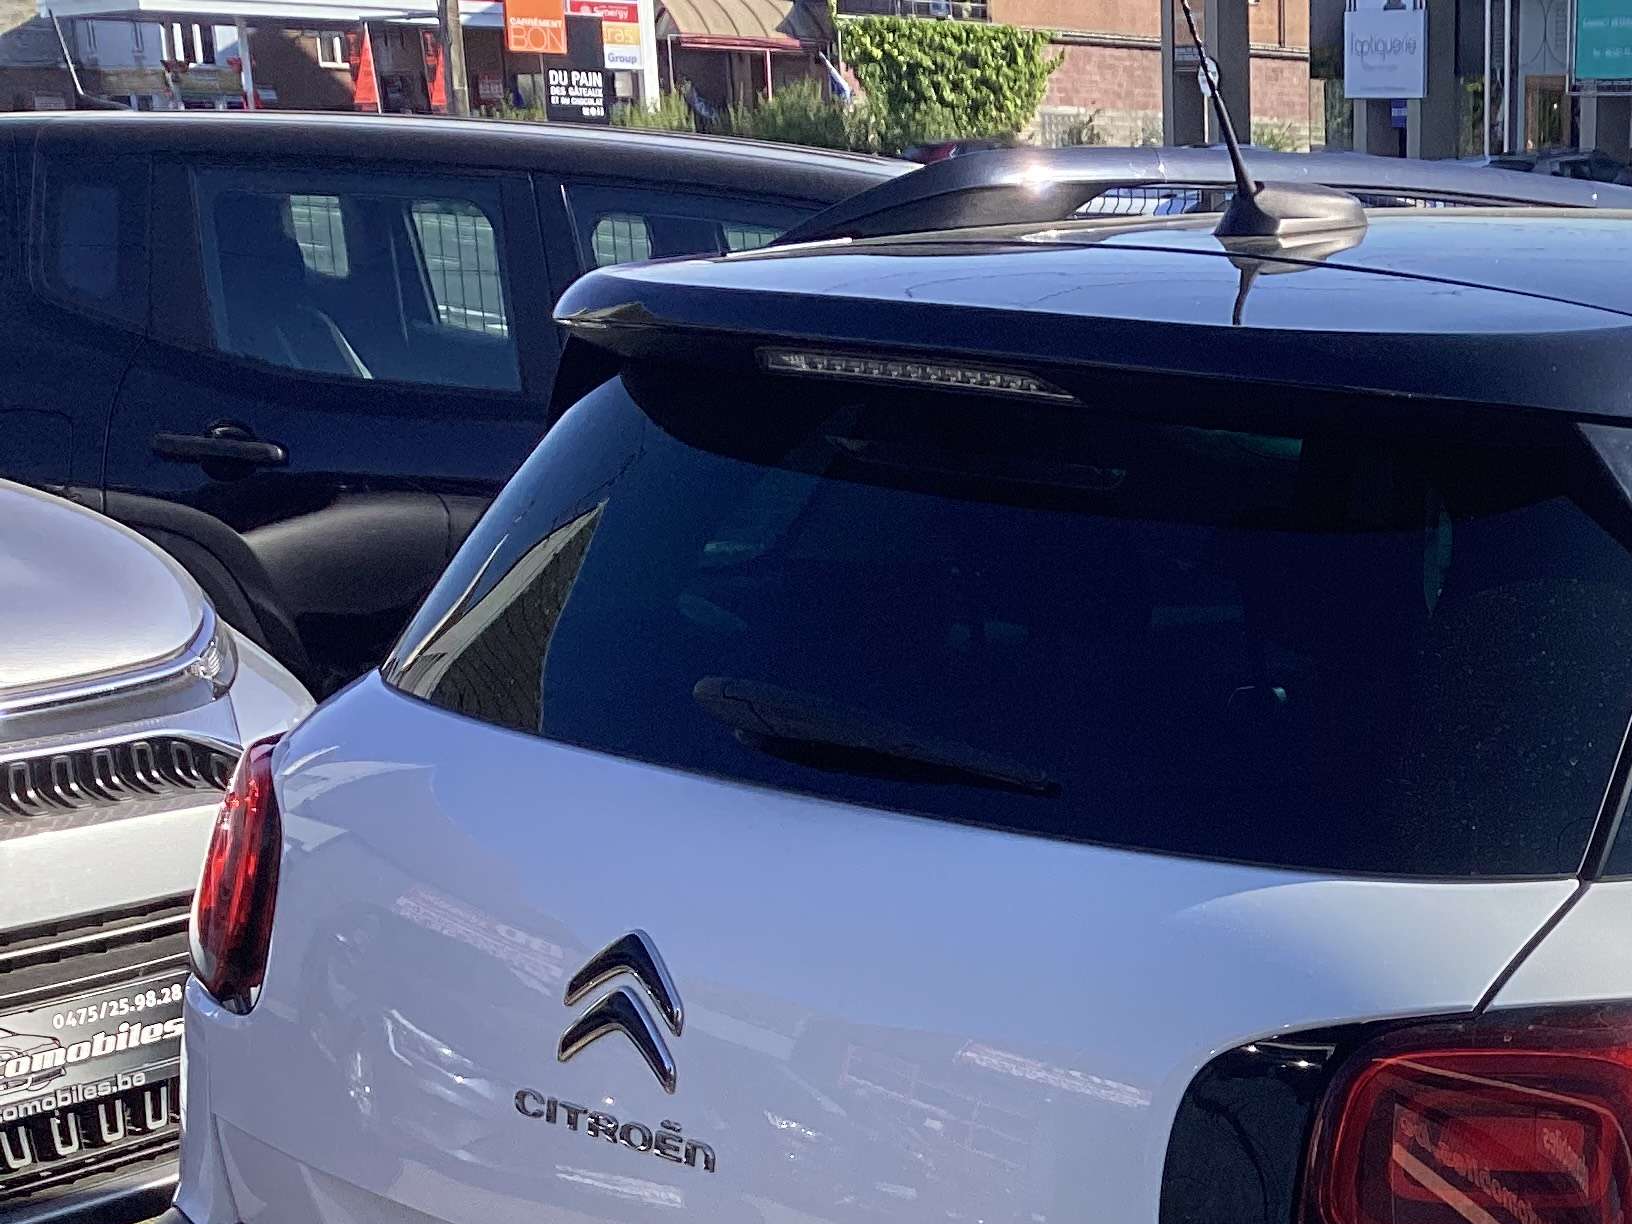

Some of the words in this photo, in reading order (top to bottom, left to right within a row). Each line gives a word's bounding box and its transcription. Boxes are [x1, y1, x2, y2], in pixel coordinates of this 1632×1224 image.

[511, 26, 563, 50] BON
[608, 53, 638, 64] Group
[549, 69, 568, 86] DU
[571, 70, 603, 87] PAIN
[550, 86, 567, 96] DES
[52, 983, 183, 1029] 0475/25.98.28
[513, 1088, 717, 1174] CITROËN
